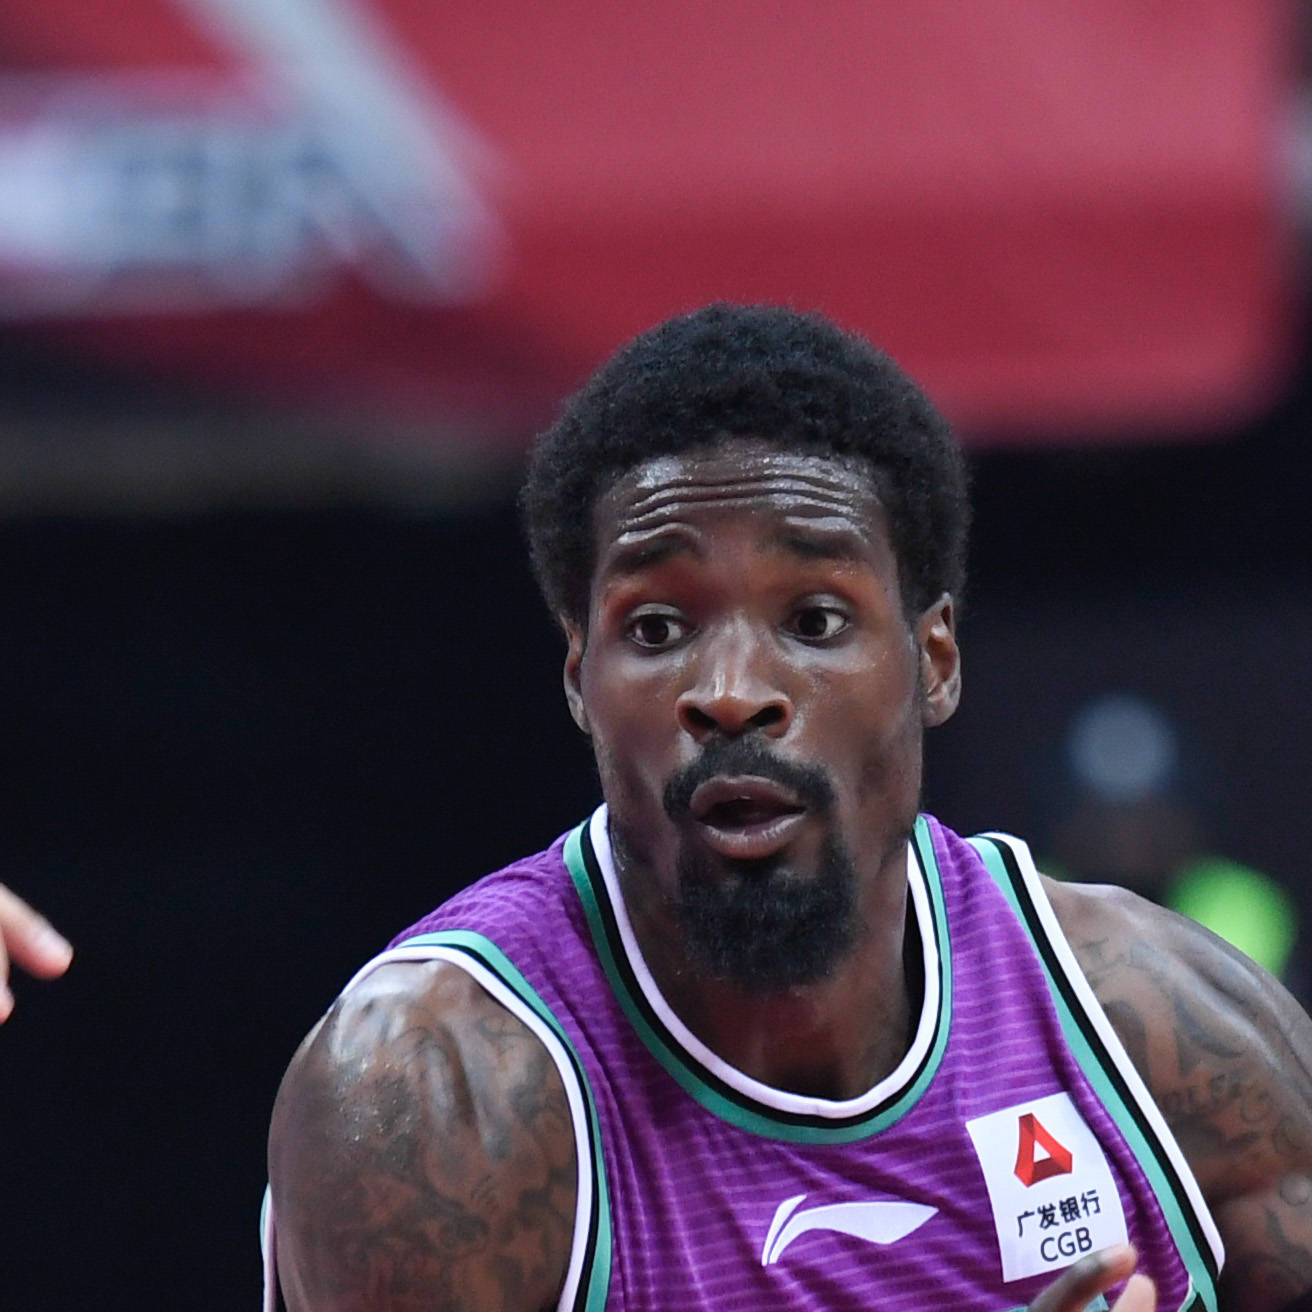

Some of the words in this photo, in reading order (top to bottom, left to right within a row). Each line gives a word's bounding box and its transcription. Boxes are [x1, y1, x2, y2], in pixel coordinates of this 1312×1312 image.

[1017, 1189, 1101, 1238] 广发银行
[1040, 1227, 1092, 1262] CGB
